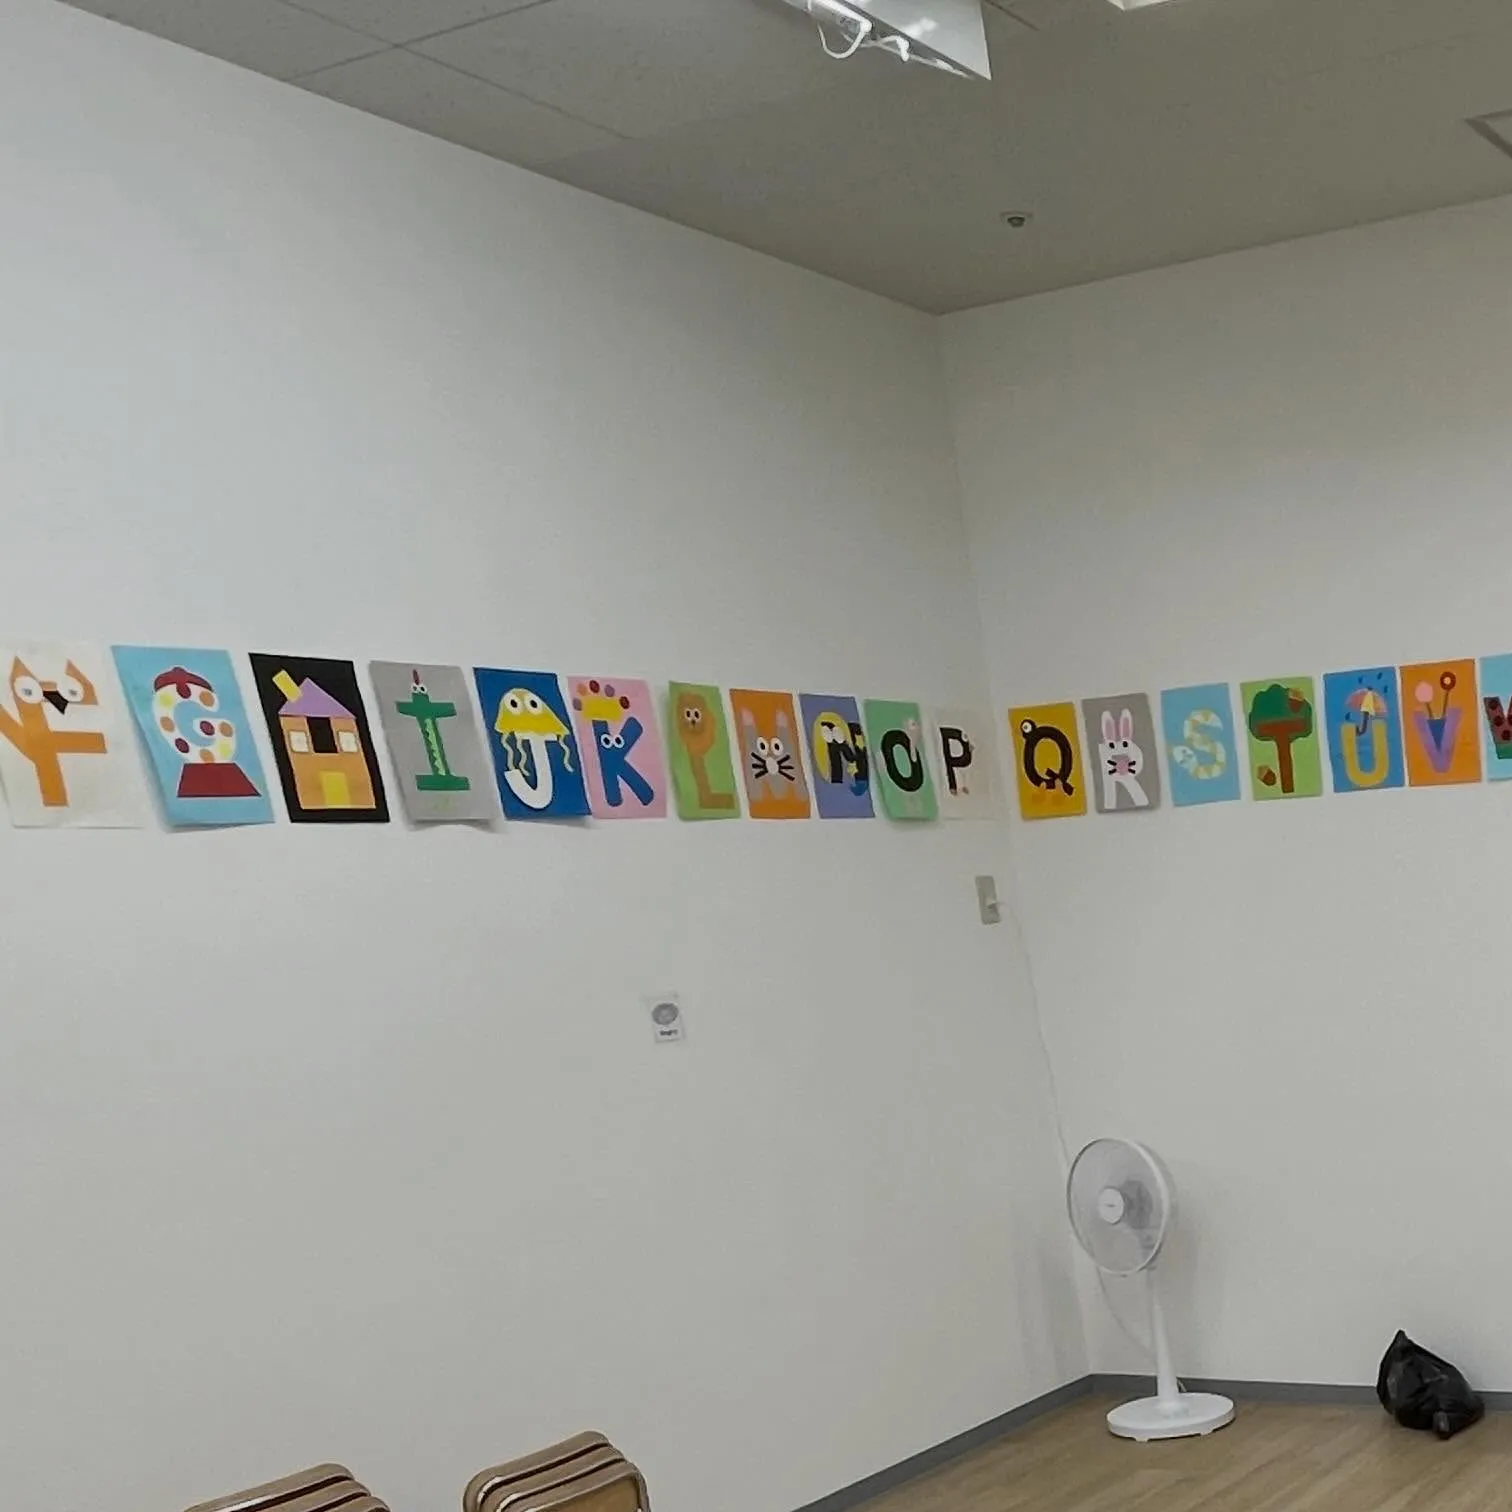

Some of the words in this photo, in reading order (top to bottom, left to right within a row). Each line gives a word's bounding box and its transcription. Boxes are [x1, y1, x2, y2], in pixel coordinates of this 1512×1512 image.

[150, 667, 243, 775] G
[396, 693, 470, 791] I
[500, 715, 566, 810] J
[591, 716, 655, 807] K
[676, 691, 735, 809] L
[741, 706, 796, 801] M
[821, 720, 870, 785] N
[881, 728, 924, 793] O
[940, 727, 974, 795] P
[1021, 720, 1075, 796] Q
[1098, 730, 1150, 809] R
[1171, 709, 1227, 780] S
[1252, 713, 1312, 793] T
[1341, 721, 1390, 787] U
[1413, 706, 1462, 773] V
